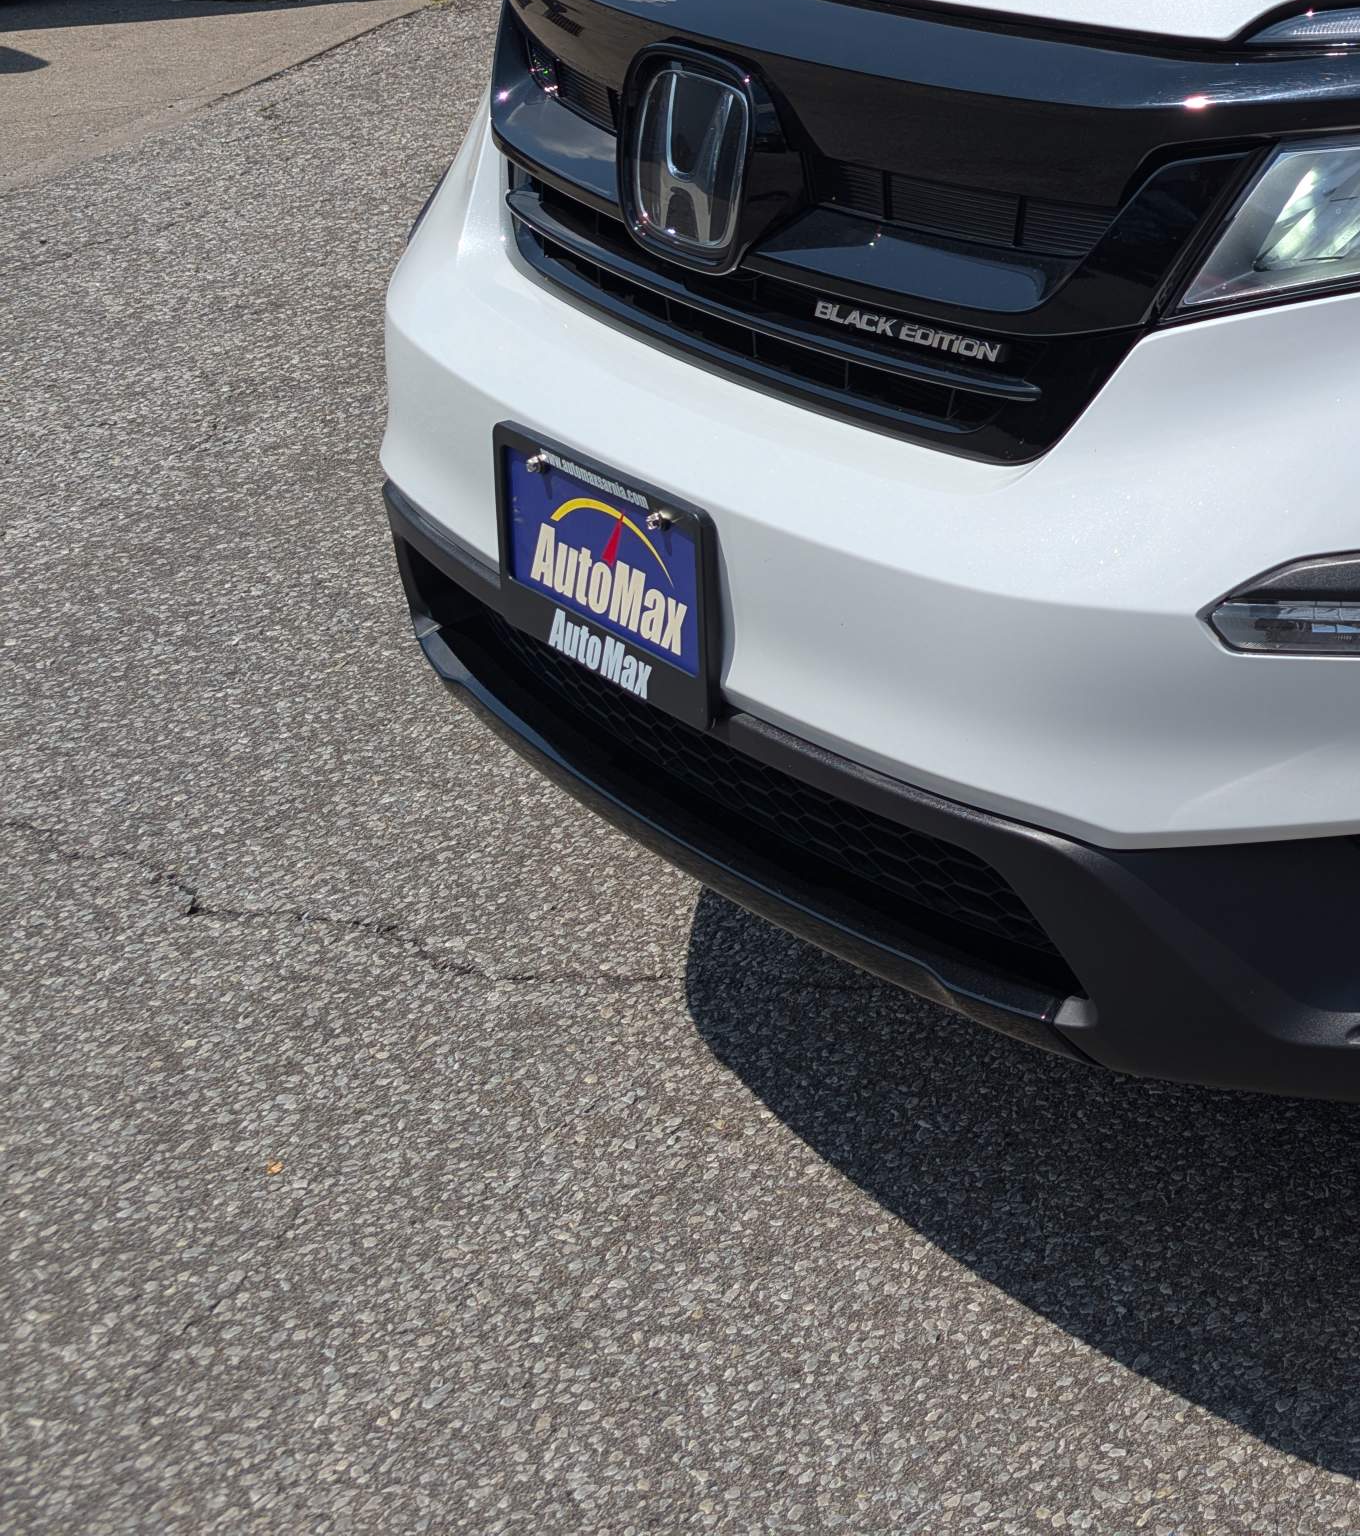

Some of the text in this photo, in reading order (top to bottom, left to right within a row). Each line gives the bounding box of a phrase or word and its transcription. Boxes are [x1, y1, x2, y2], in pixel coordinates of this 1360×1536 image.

[814, 300, 1001, 362] BLACK EDITION
[530, 521, 689, 655] AutoMax
[547, 608, 652, 701] AutoMax
